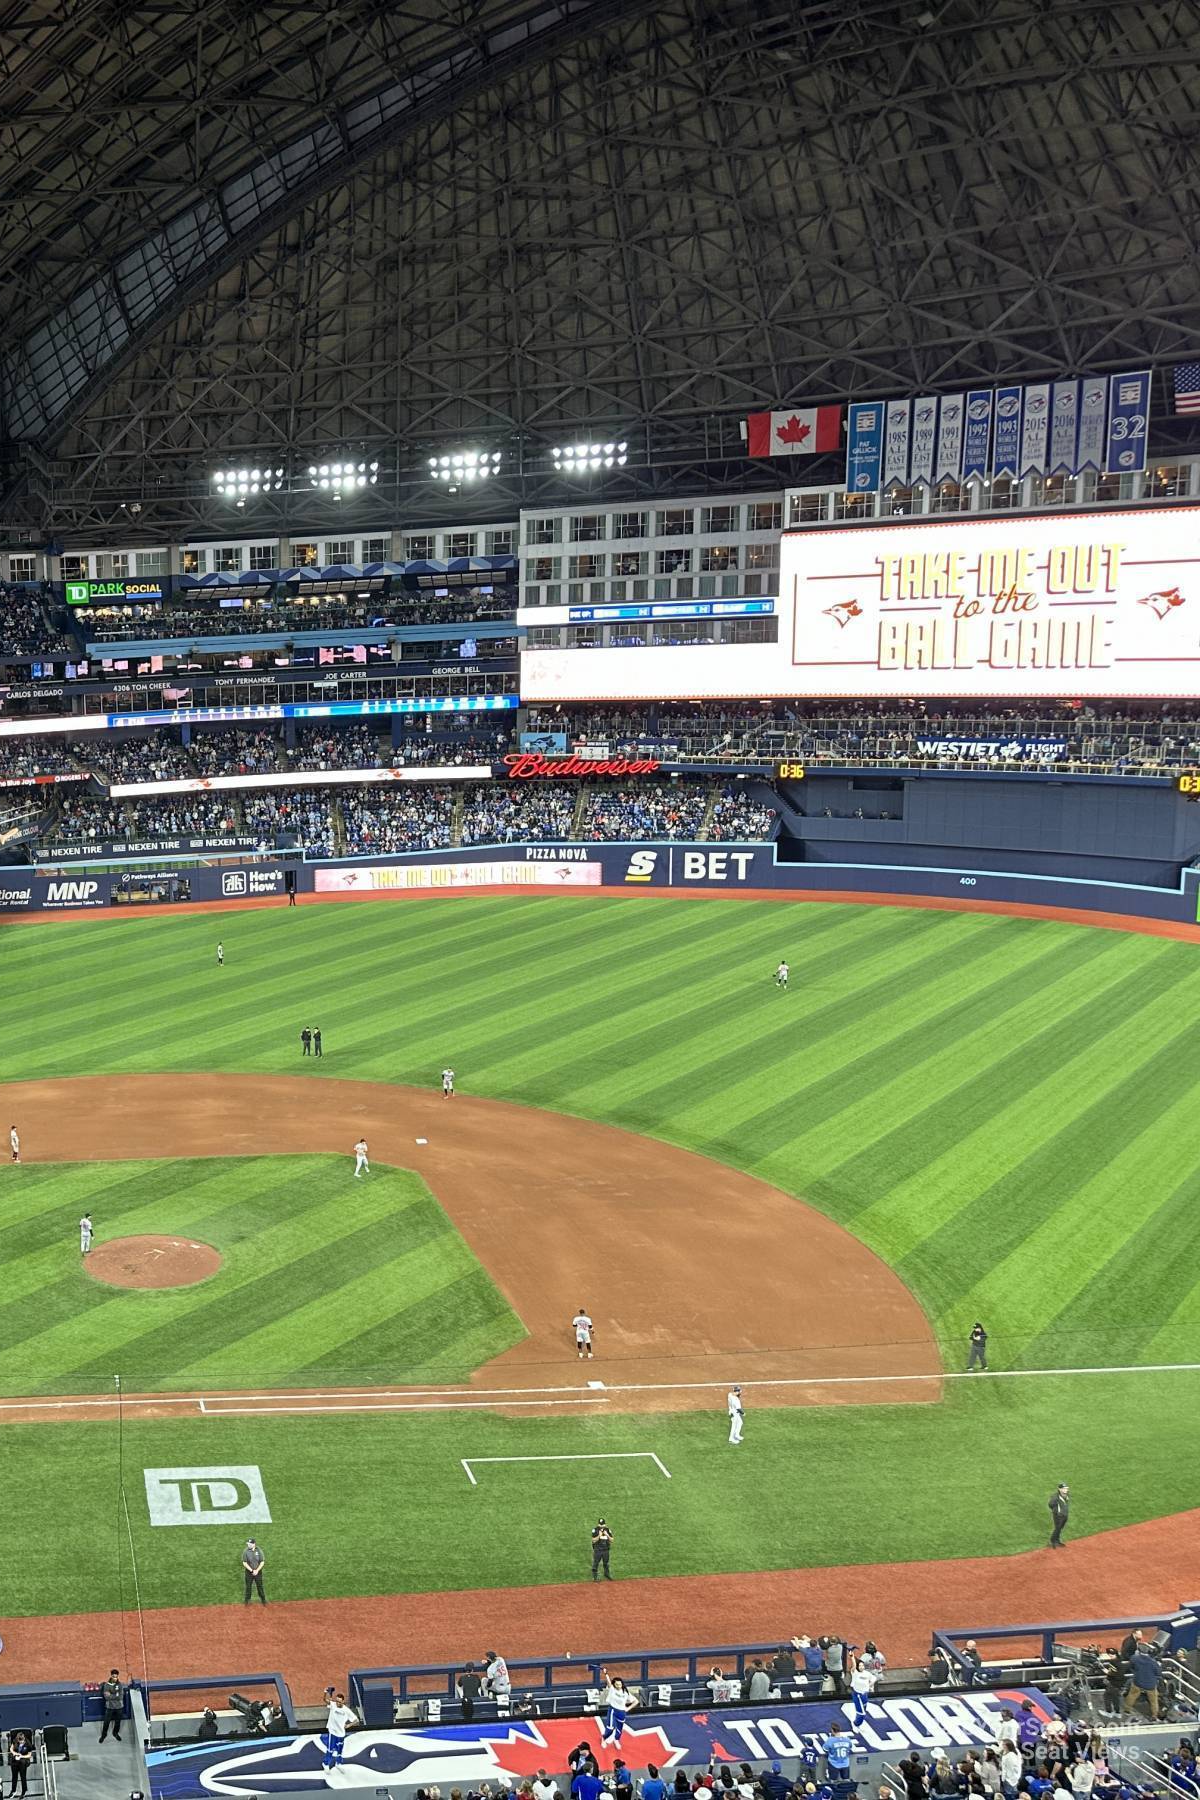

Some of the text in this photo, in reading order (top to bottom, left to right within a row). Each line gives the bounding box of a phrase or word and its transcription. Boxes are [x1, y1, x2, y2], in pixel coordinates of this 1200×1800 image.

[998, 421, 1017, 434] 1993
[1025, 417, 1046, 431] 2015
[1054, 415, 1075, 428] 2016
[1111, 414, 1146, 441] 32
[915, 428, 933, 441] 1989
[942, 427, 959, 439] 1991
[968, 423, 987, 437] 1992
[888, 431, 907, 443] 1985
[887, 455, 905, 464] EAST
[940, 451, 957, 460] EAST
[875, 543, 1126, 601] TAKE ME OUT
[67, 582, 162, 600] TD PARK SOCIAL
[953, 583, 1039, 619] to the
[877, 614, 1115, 670] BALL GAME
[324, 671, 367, 680] JOE CARTER
[432, 666, 481, 675] GEORGE BELL
[113, 682, 172, 692] 4306 TOM CHEEK
[214, 676, 276, 686] TONY FERNANDEZ
[6, 688, 64, 700] CARLOS DELGADO
[1025, 743, 1065, 753] FLIGHT
[503, 753, 661, 779] Budweiser
[780, 764, 805, 778] 0:36
[6, 778, 21, 787] Blue
[21, 778, 36, 787] Jays
[61, 774, 82, 782] ROGERS
[128, 843, 158, 852] NEXEN
[160, 841, 180, 849] TIRE
[206, 839, 236, 847] NEXEN
[237, 837, 258, 845] TIRE
[51, 847, 80, 857] NEXEN
[81, 845, 102, 854] TIRE
[526, 847, 588, 861] PIZZA NOVA
[627, 850, 755, 880] S BET
[250, 869, 283, 881] Here's
[250, 881, 277, 892] How.
[959, 877, 977, 886] 400
[47, 881, 98, 901] MNP
[159, 1477, 252, 1512] TD
[723, 1717, 806, 1759] TO
[841, 1692, 1002, 1752] CORE
[836, 1747, 847, 1758] 16
